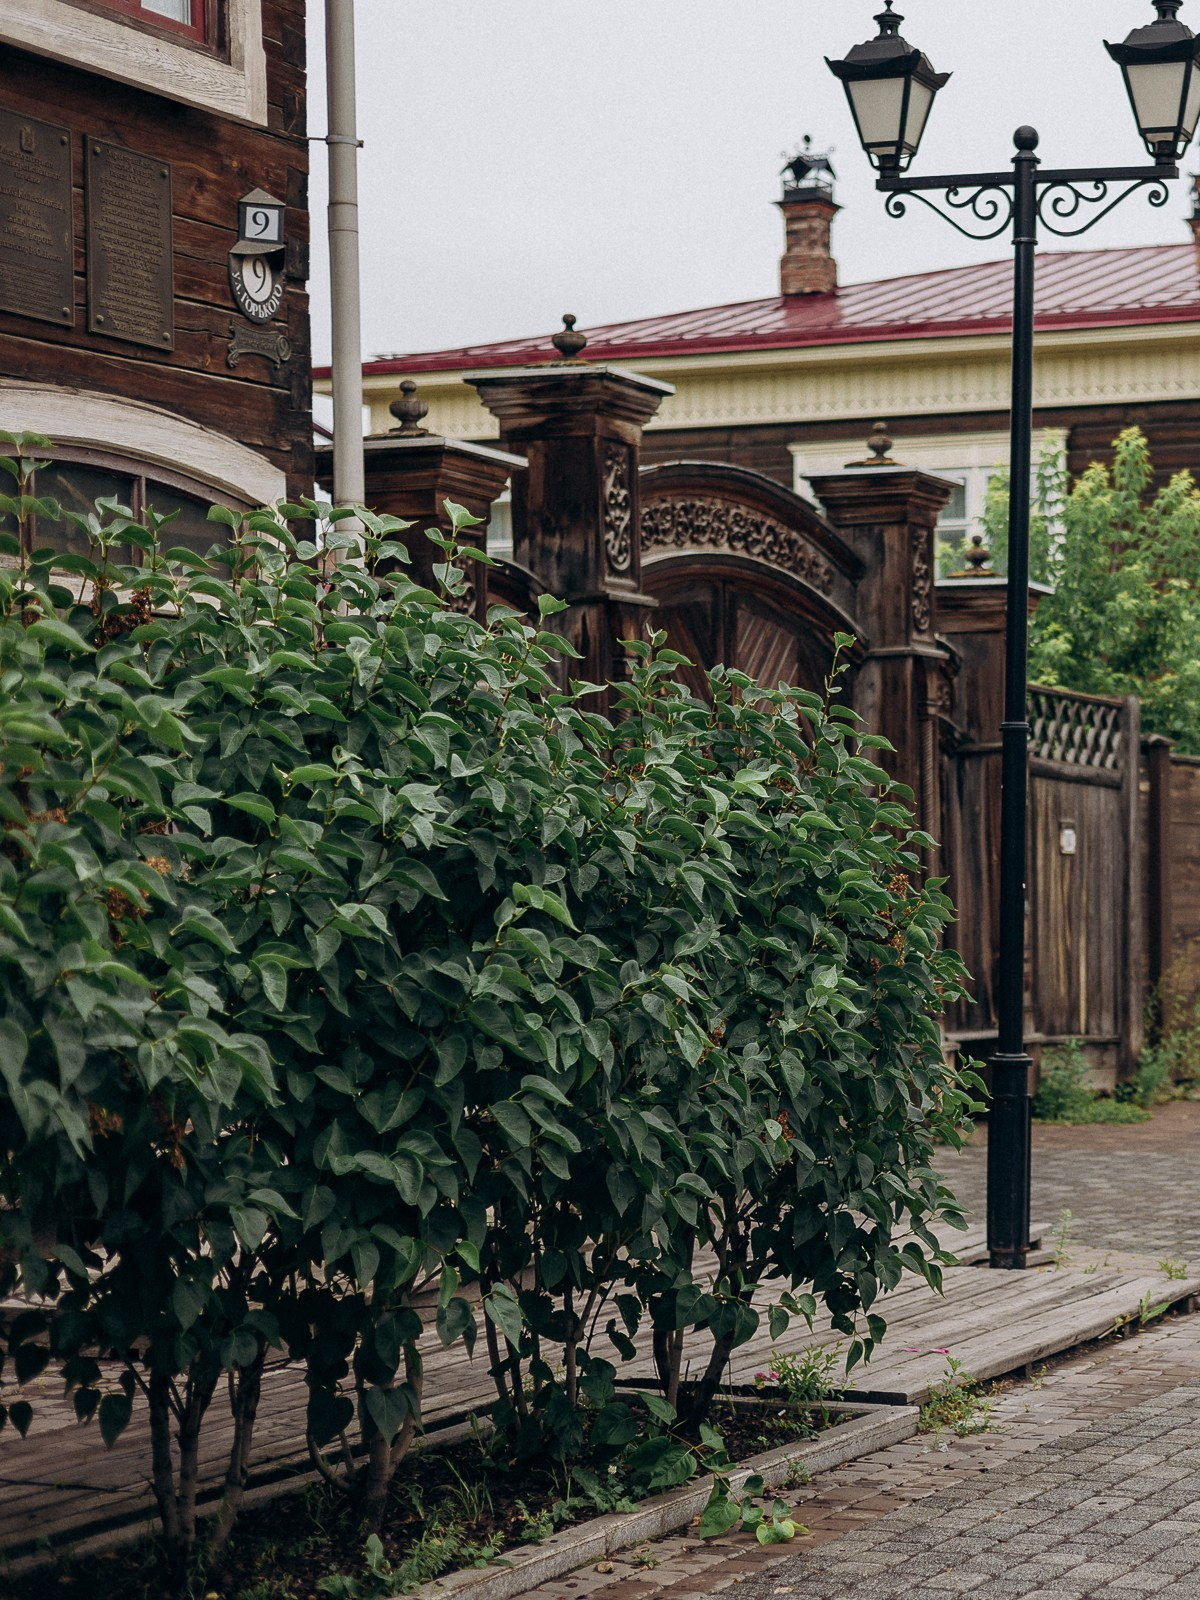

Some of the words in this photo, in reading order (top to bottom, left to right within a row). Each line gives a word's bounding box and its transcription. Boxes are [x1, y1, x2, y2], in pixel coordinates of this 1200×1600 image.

[252, 210, 270, 236] 9
[252, 258, 266, 294] 9
[240, 284, 283, 319] ГОРЬКОГО
[279, 337, 289, 359] 9
